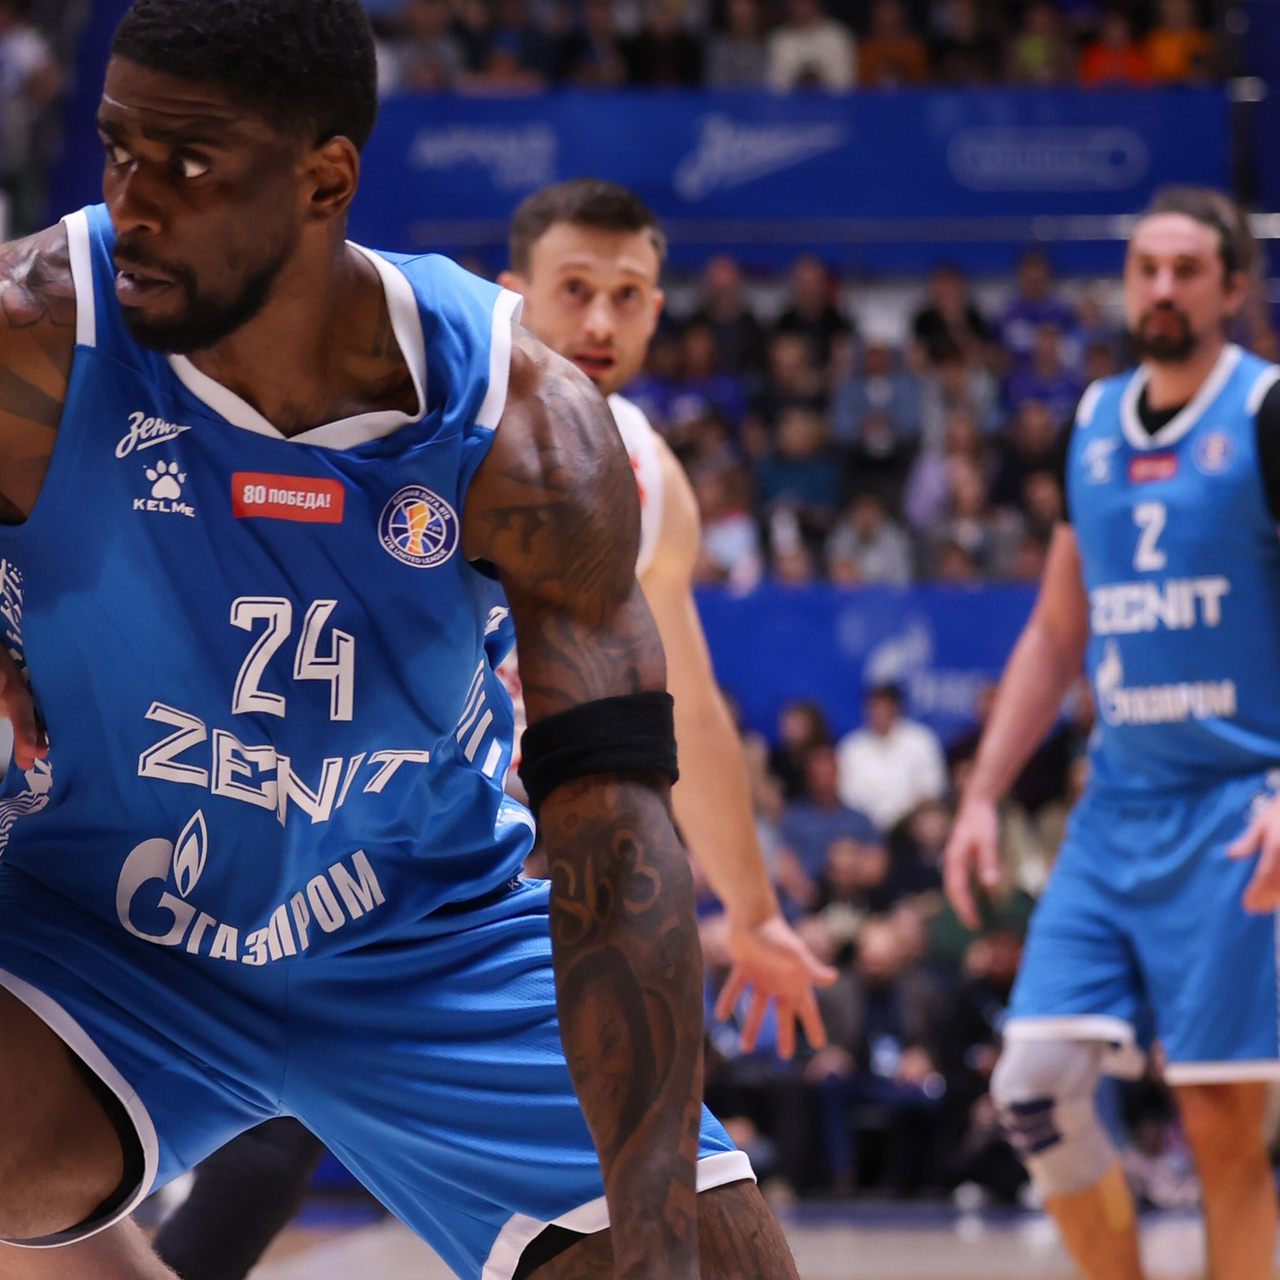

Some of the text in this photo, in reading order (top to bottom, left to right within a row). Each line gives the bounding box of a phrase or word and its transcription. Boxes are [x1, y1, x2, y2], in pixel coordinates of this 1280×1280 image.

[133, 498, 196, 518] KELME
[243, 484, 332, 509] 80 ПОБЕДА!
[1132, 500, 1168, 572] 2
[230, 596, 355, 721] 24
[137, 701, 429, 825] ZENIT
[186, 849, 386, 967] ГАЗПРОМ
